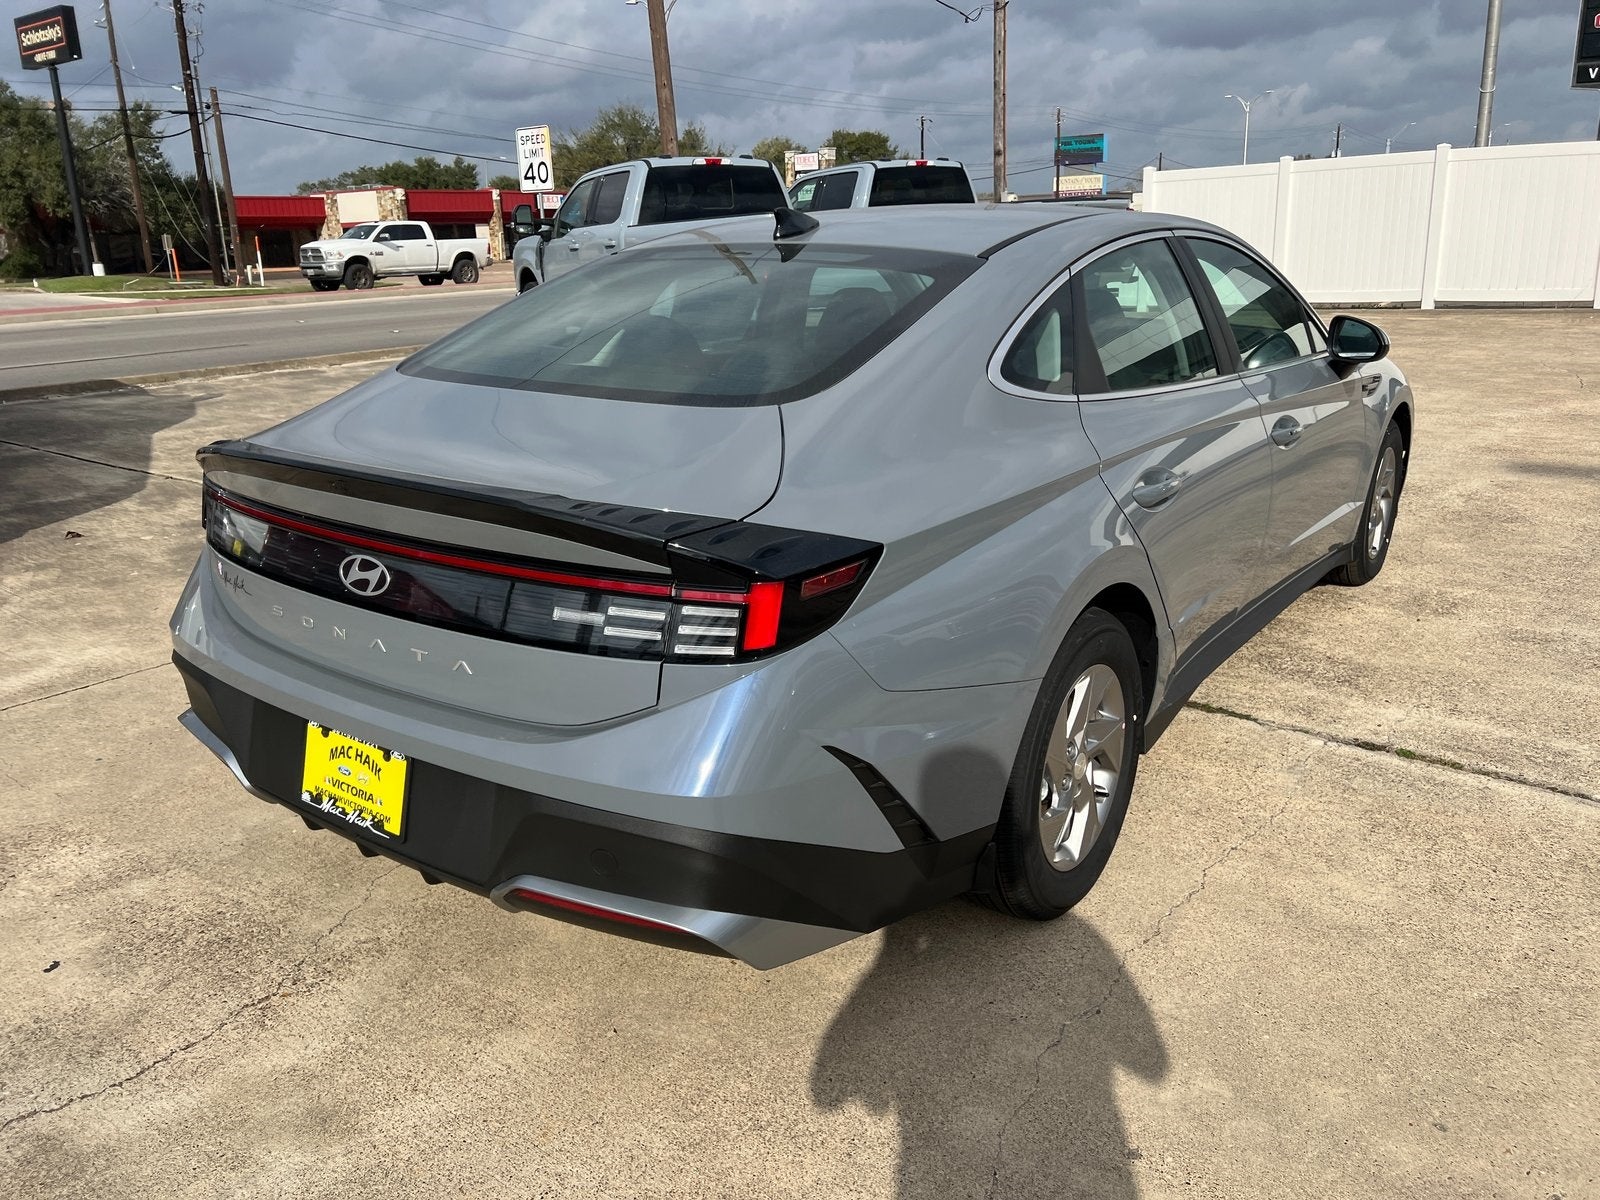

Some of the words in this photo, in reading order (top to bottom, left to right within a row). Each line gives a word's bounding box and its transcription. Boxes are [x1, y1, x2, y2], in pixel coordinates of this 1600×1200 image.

[21, 24, 61, 47] Schlotzsky's
[520, 133, 546, 146] SPEED
[523, 147, 544, 159] LIMIT
[523, 161, 549, 184] 40
[271, 605, 473, 676] SONATA
[329, 745, 353, 762] MAC
[354, 748, 382, 782] HAIK
[331, 776, 375, 804] VICTORIA
[316, 797, 346, 819] Mac
[345, 809, 380, 833] Haik
